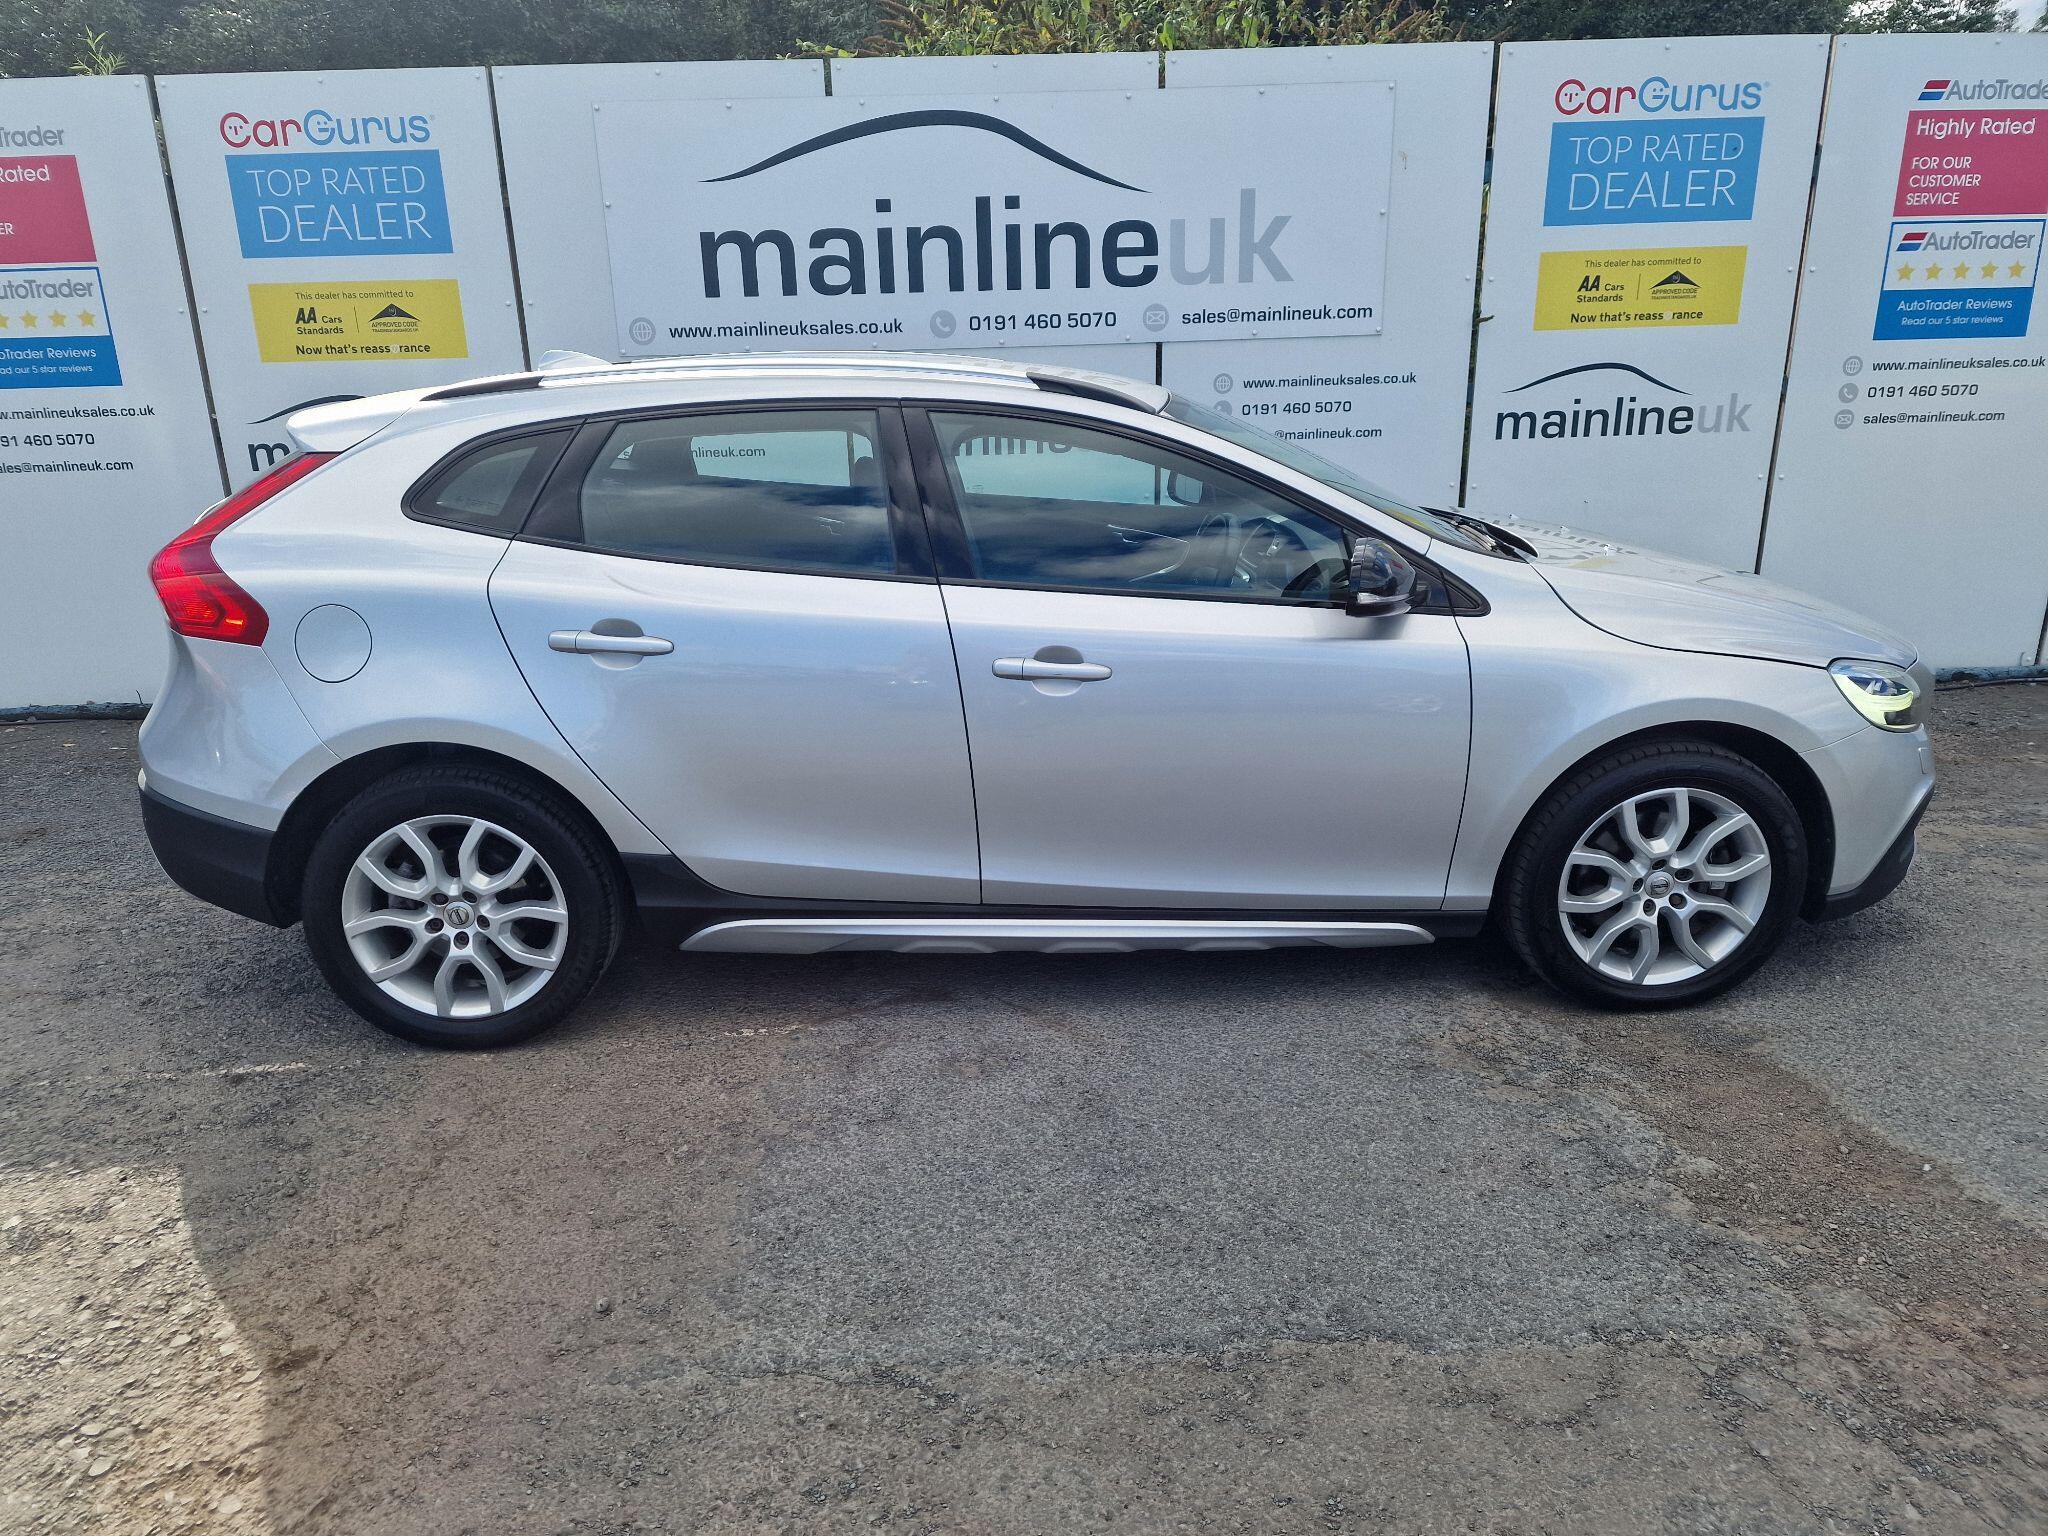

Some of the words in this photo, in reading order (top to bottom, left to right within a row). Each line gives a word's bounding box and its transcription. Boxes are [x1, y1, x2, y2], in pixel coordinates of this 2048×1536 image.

[1555, 76, 1762, 115] CarGurus
[220, 109, 431, 148] CarGurus
[1917, 118, 1976, 140] Highly
[1980, 117, 2036, 135] Rated
[1569, 136, 1633, 165] TOP
[1642, 133, 1744, 163] RATED
[1912, 156, 1939, 170] FOR
[1943, 156, 1972, 169] OUR
[246, 168, 311, 197] TOP
[321, 165, 425, 196] RATED
[1909, 174, 1982, 188] CUSTOMER
[1568, 168, 1736, 211] DEALER
[1906, 192, 1960, 206] SERVICE
[258, 202, 432, 243] DEALER
[700, 188, 1294, 298] mainlineuk
[1922, 230, 2035, 251] AutoTrader
[1585, 259, 1602, 268] This
[1604, 258, 1630, 268] dealer
[1631, 258, 1646, 267] has
[1647, 257, 1692, 266] committed
[1693, 257, 1702, 265] to
[1577, 275, 1601, 292] AA
[1604, 283, 1625, 292] Cars
[295, 292, 313, 300] This
[314, 291, 340, 300] dealer
[342, 290, 357, 299] has
[359, 289, 404, 299] committed
[405, 290, 414, 298] to
[1576, 294, 1624, 303] Standards
[1897, 299, 1963, 311] AutoTrader
[1965, 298, 2013, 310] Reviews
[295, 307, 317, 324] AA
[321, 315, 343, 324] Cars
[969, 314, 1017, 331] 0191
[1024, 313, 1062, 330] 460
[1067, 311, 1117, 328] 5070
[1182, 304, 1374, 325] sales@mainlineuk.com
[1570, 313, 1597, 324] Now
[1599, 311, 1631, 323] that's
[1634, 311, 1703, 321] reassrance
[1901, 316, 1927, 326] Read
[1928, 317, 1943, 325] our
[1945, 316, 1951, 325] 5
[1953, 315, 1970, 324] star
[1971, 315, 2004, 324] reviews
[296, 326, 345, 335] Standards
[668, 318, 903, 338] www.mainlineuksales.co.uk
[46, 347, 97, 358] Reviews
[295, 344, 322, 355] Now
[325, 344, 358, 354] that's
[361, 343, 431, 354] reassrance
[15, 367, 30, 375] our
[32, 365, 38, 374] 5
[40, 364, 56, 373] star
[59, 364, 93, 373] reviews
[1872, 356, 2046, 371] www.mainlineuksales.co.uk
[1243, 372, 1417, 389] www.mainlineuksales.co.uk
[1867, 386, 1904, 398] 0191
[1909, 385, 1937, 397] 460
[1941, 384, 1979, 396] 5070
[1242, 403, 1277, 416] 0191
[1283, 402, 1311, 414] 460
[1315, 401, 1352, 413] 5070
[1495, 392, 1752, 441] mainlineuk
[1863, 410, 2006, 425] sales@mainlineuk.com
[23, 434, 53, 447] 460
[56, 433, 95, 446] 5070
